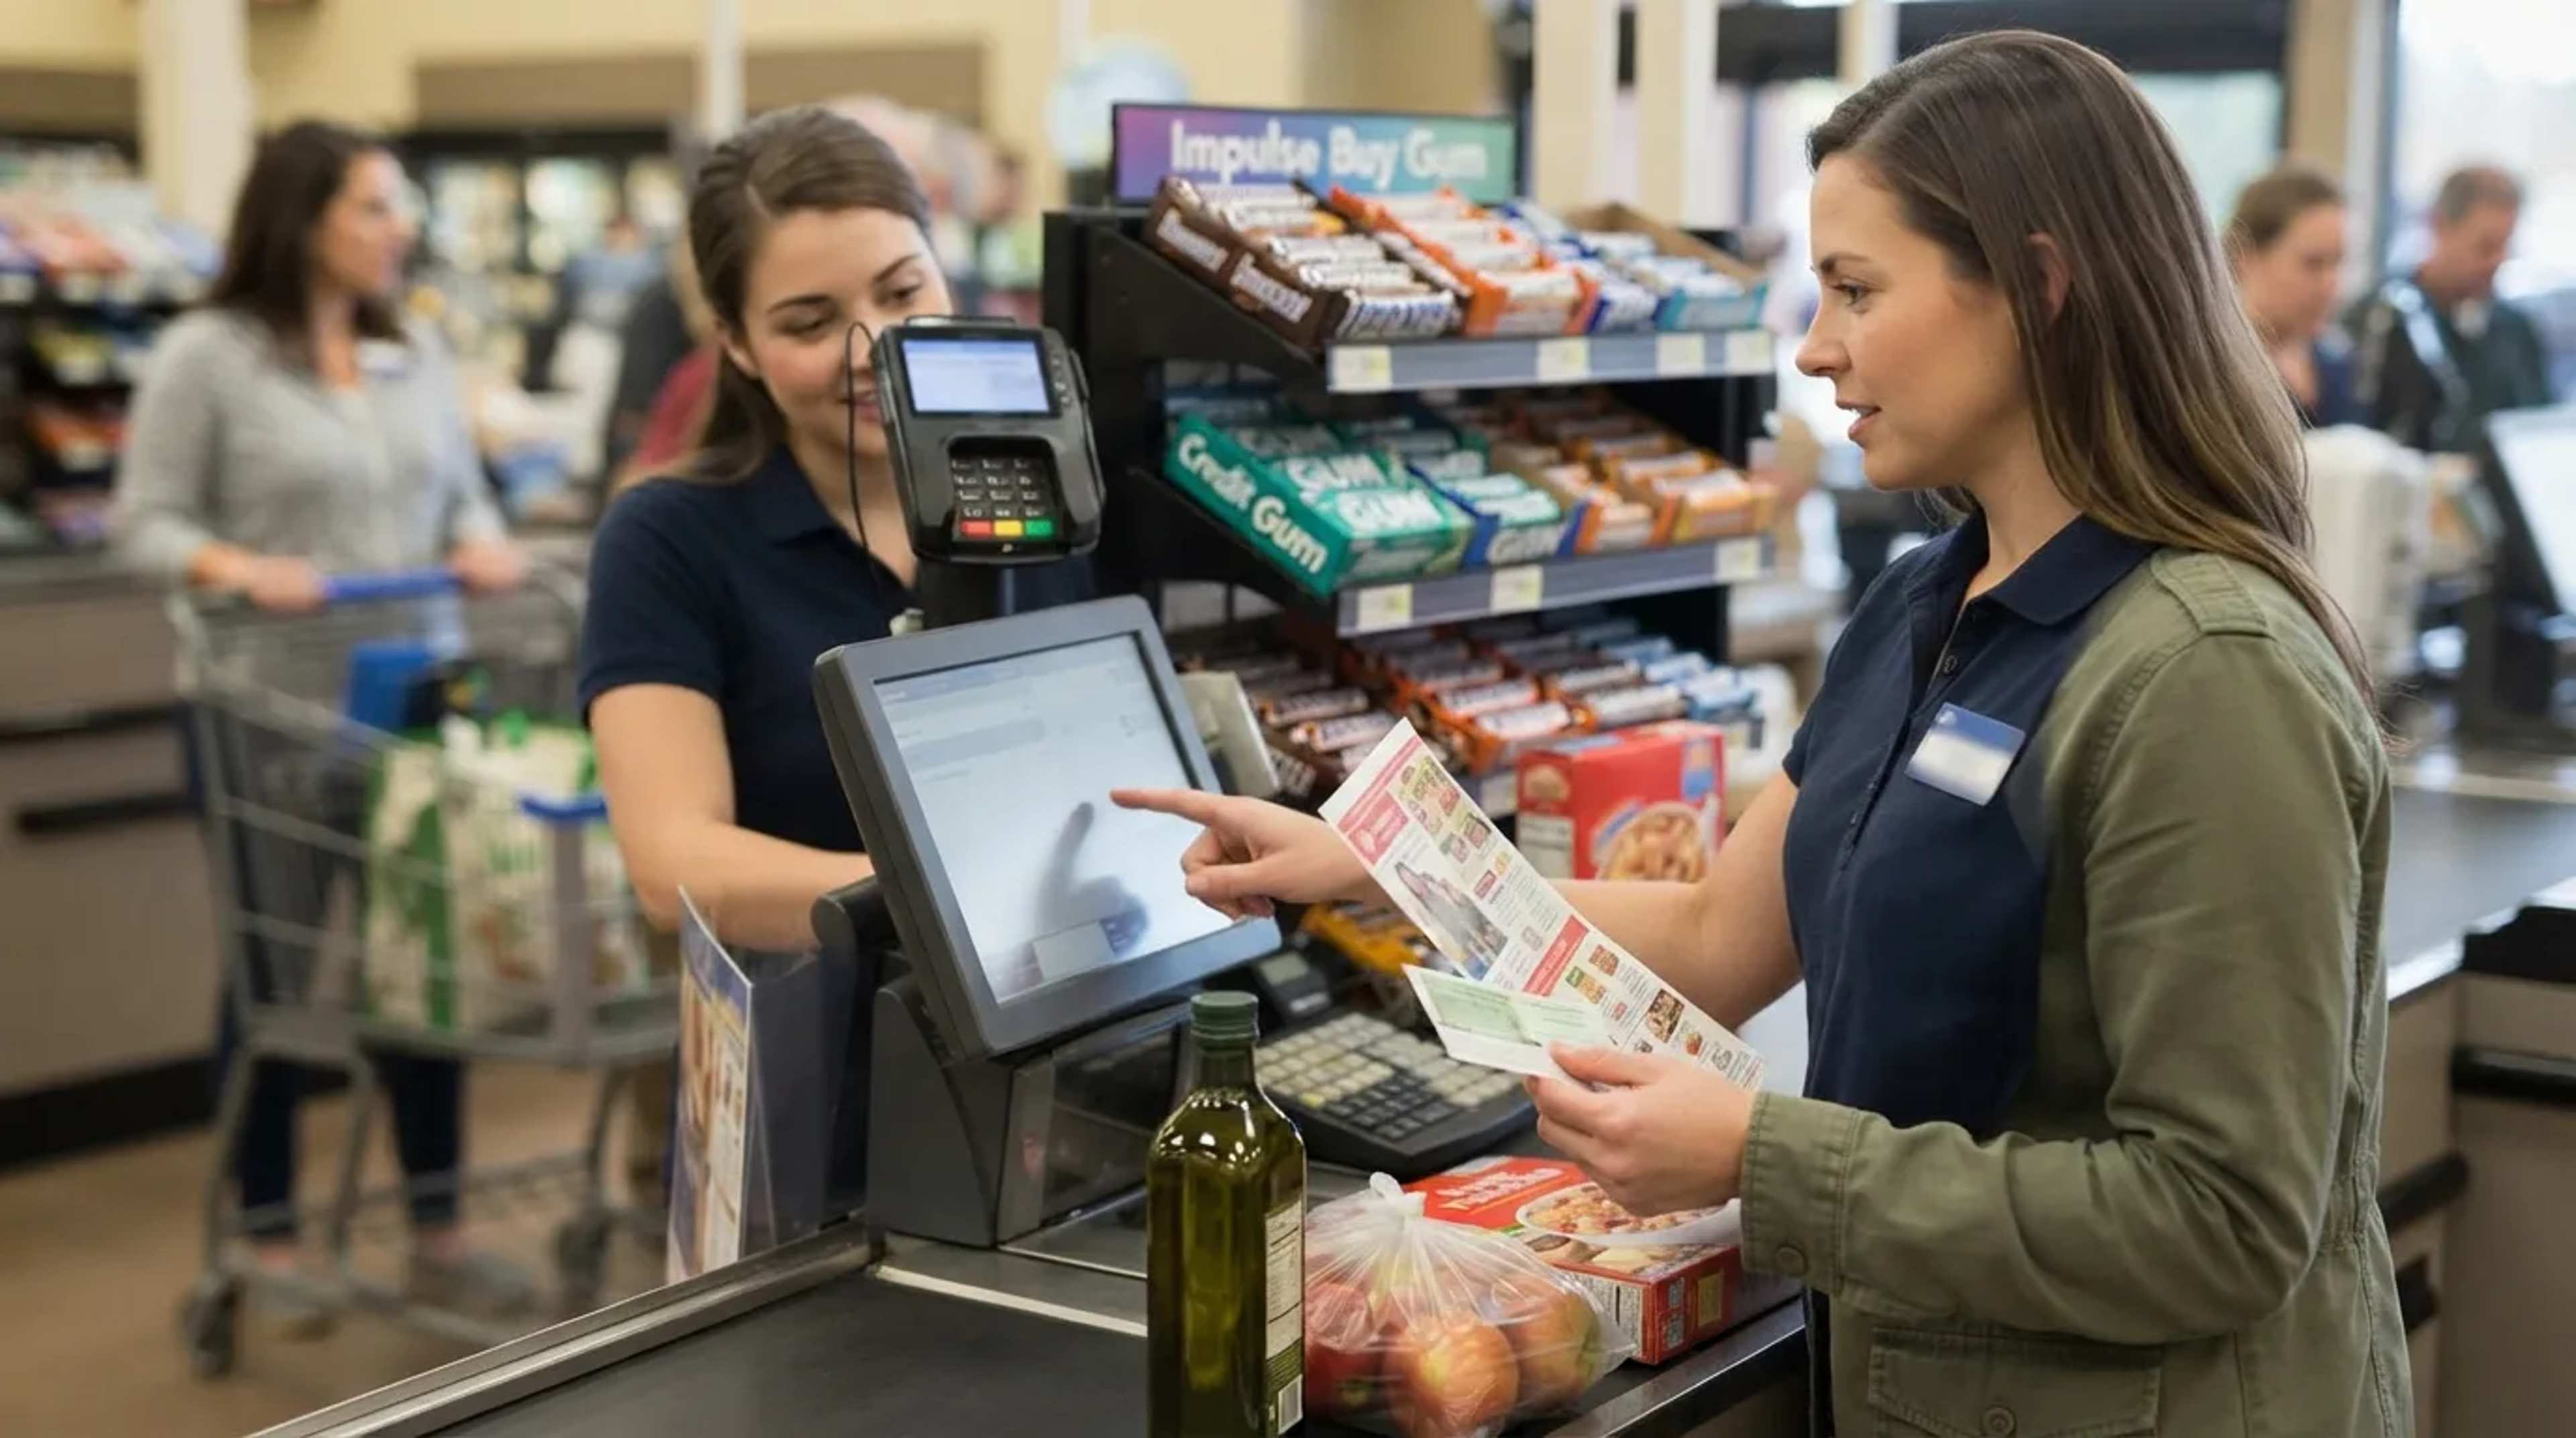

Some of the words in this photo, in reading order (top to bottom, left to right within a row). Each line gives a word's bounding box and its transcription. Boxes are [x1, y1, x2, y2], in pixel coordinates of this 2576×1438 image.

[1171, 118, 1320, 186] Impulse
[1328, 125, 1399, 193] Buy
[1407, 127, 1487, 180] Gum
[1252, 495, 1328, 574] Gum
[1336, 489, 1443, 534] GUM
